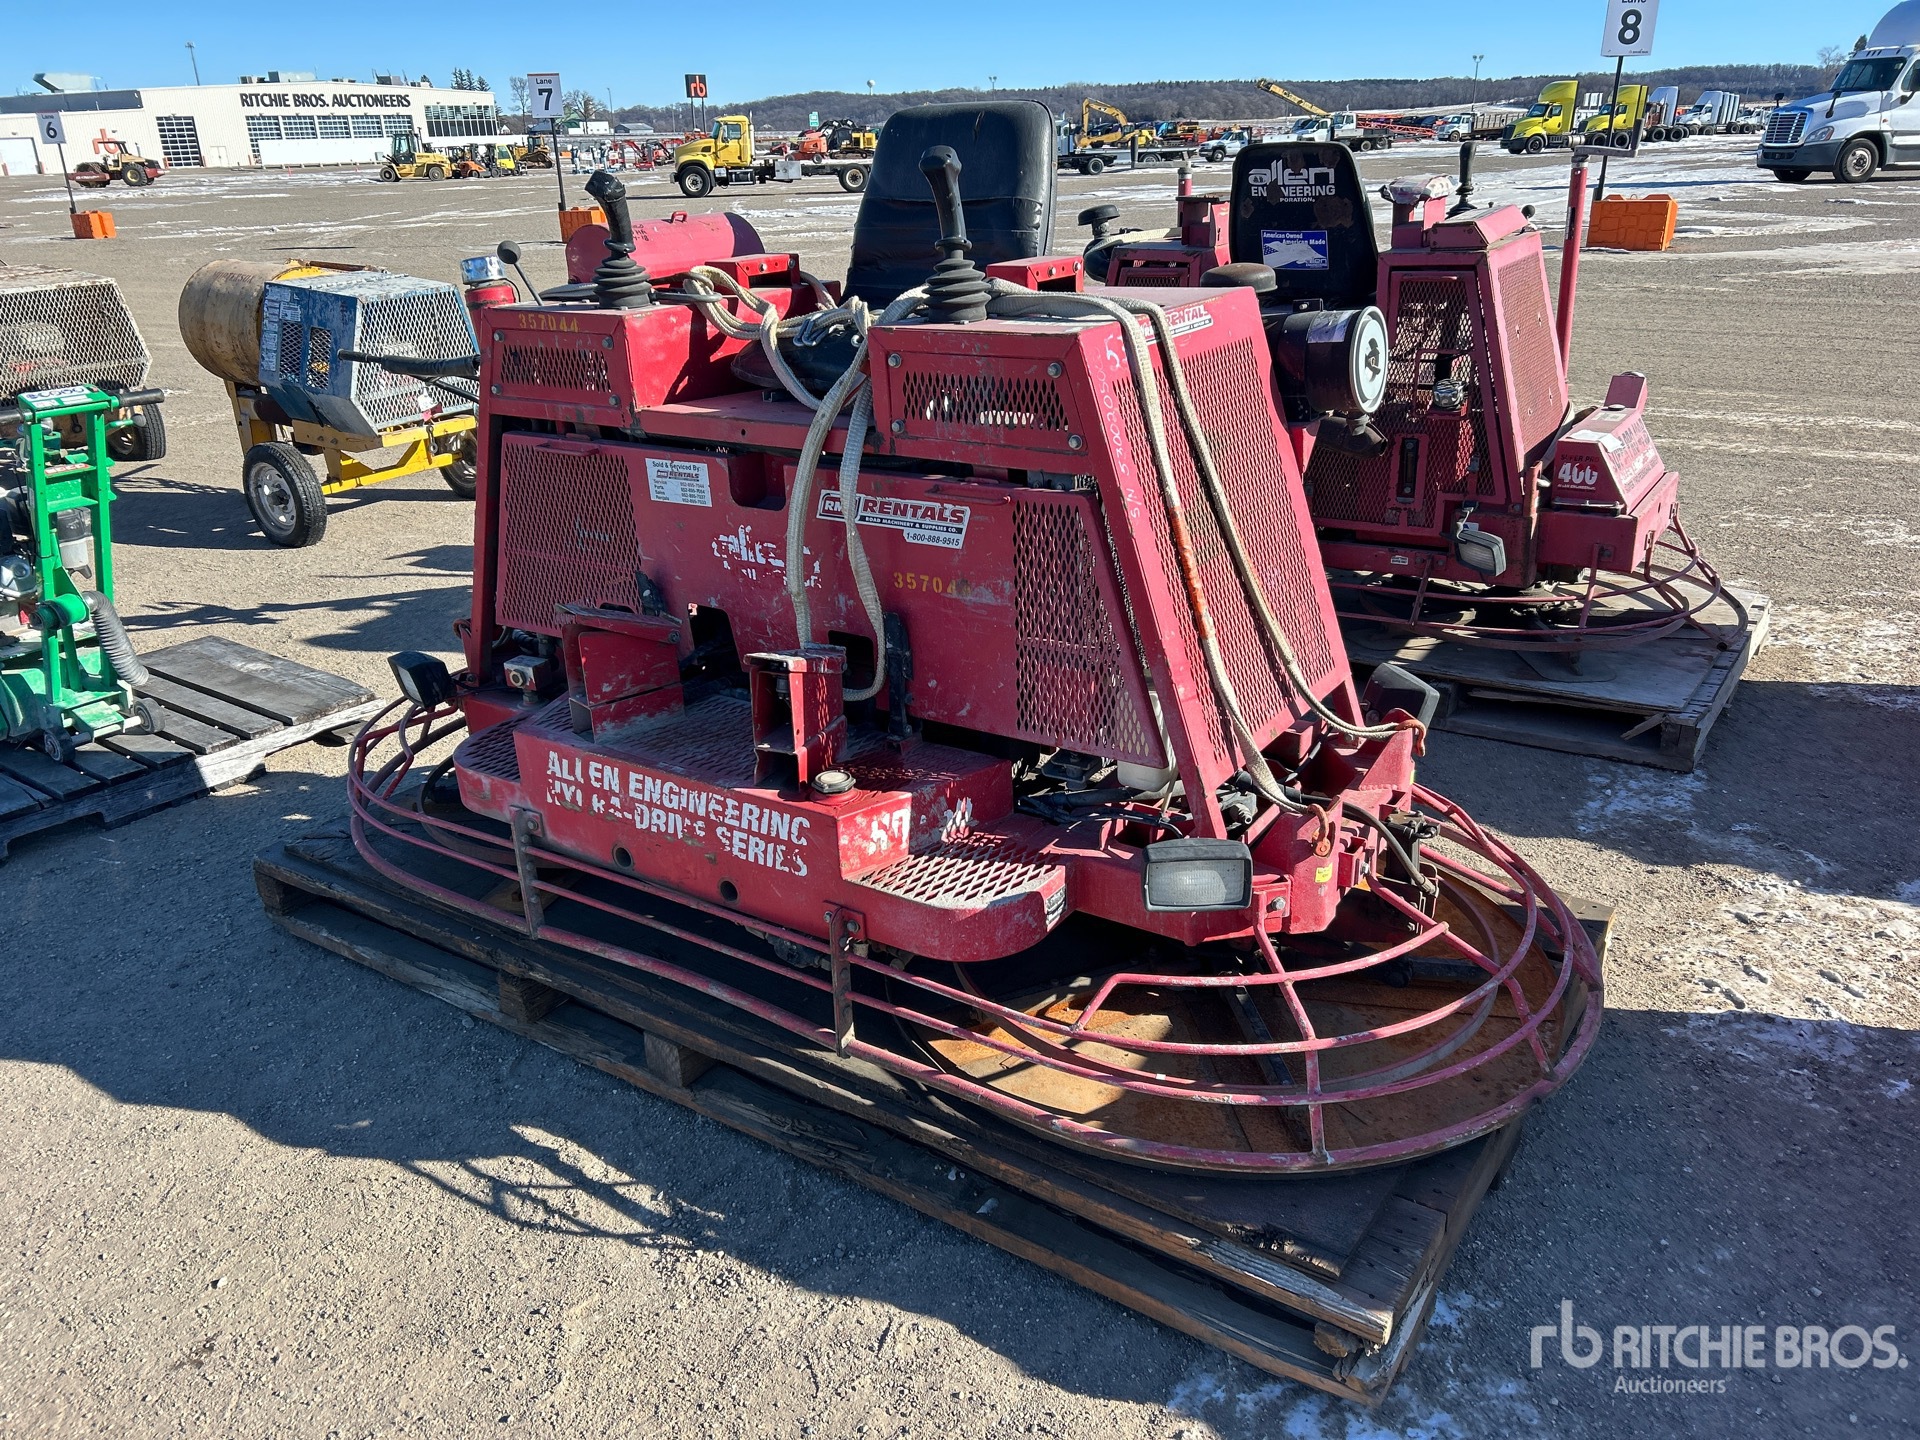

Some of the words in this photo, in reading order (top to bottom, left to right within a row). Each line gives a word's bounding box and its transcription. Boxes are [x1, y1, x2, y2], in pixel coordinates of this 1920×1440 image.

[1617, 8, 1642, 45] 8
[535, 77, 553, 85] Lane
[690, 75, 706, 97] rb
[239, 93, 291, 107] RITCHIE
[292, 93, 330, 108] BROS.
[331, 94, 412, 108] AUCTIONEERS
[538, 88, 553, 111] 7
[46, 121, 58, 139] 6
[1248, 159, 1335, 186] allen
[1251, 185, 1336, 197] ENNEERING
[518, 313, 579, 333] 357044
[669, 470, 700, 479] RENTALS
[670, 463, 691, 471] Serviced
[862, 499, 965, 524] RENTALS
[881, 519, 914, 528] MACHINERY
[921, 524, 947, 532] SUPPLIES
[906, 531, 961, 547] 1-800-888-9515
[546, 750, 620, 794] ALLEN
[628, 771, 811, 847] ENGINEERING
[716, 825, 809, 878] SERIES
